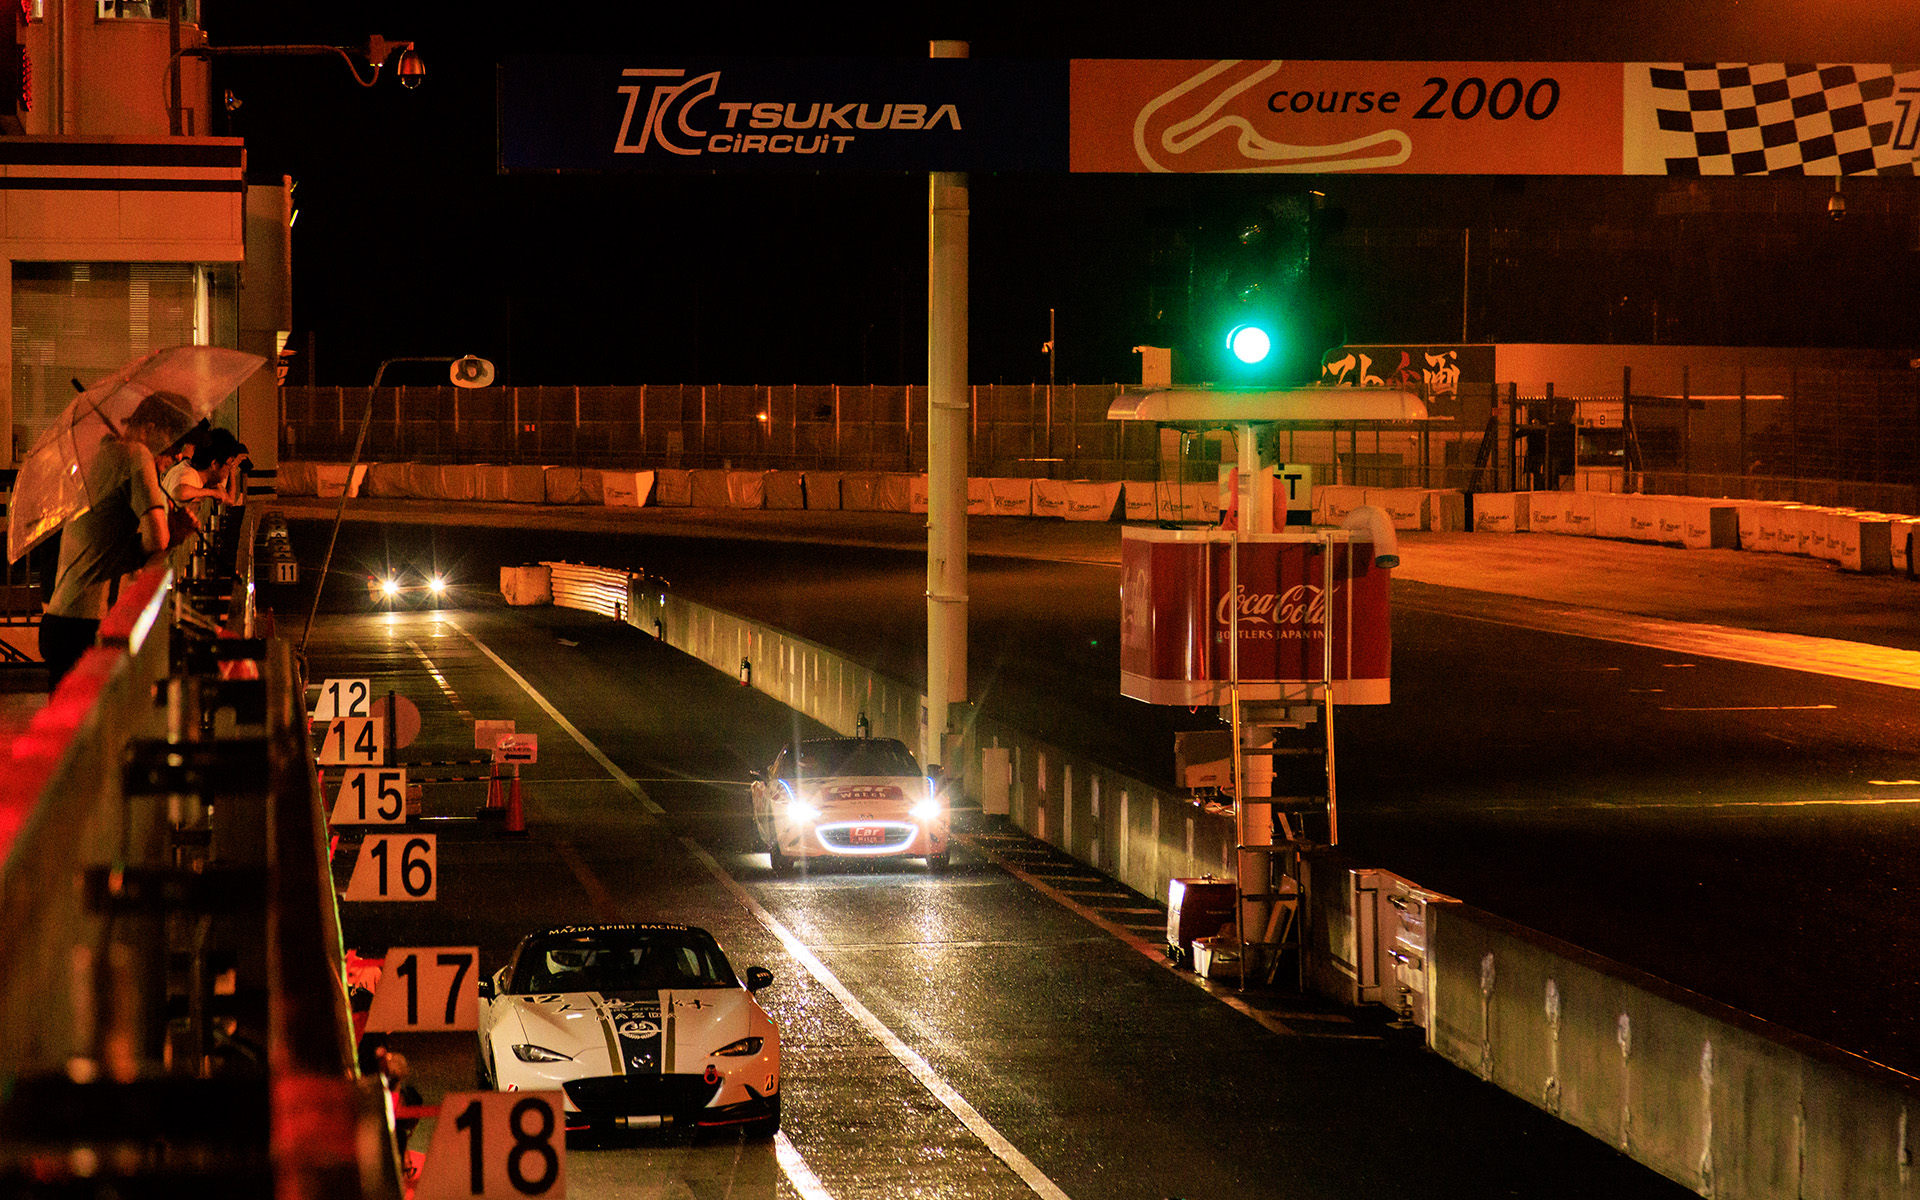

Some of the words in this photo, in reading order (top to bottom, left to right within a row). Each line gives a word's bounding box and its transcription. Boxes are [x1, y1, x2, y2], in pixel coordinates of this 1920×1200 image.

[718, 102, 962, 131] TSUKUBA
[1267, 87, 1400, 114] course
[1413, 77, 1561, 121] 2000
[281, 564, 294, 581] 11
[1217, 629, 1273, 640] BOTLERS
[1276, 629, 1311, 640] JAPAN
[329, 681, 367, 718] 12
[333, 720, 378, 762] 14
[351, 772, 403, 821] 15
[854, 827, 880, 837] Car
[371, 838, 433, 897] 16
[548, 925, 596, 936] MAZDA
[599, 923, 637, 931] SPIRIT
[641, 923, 689, 932] RACING
[396, 953, 474, 1025] 17
[595, 1012, 680, 1021] MAZDA
[455, 1096, 560, 1197] 18
